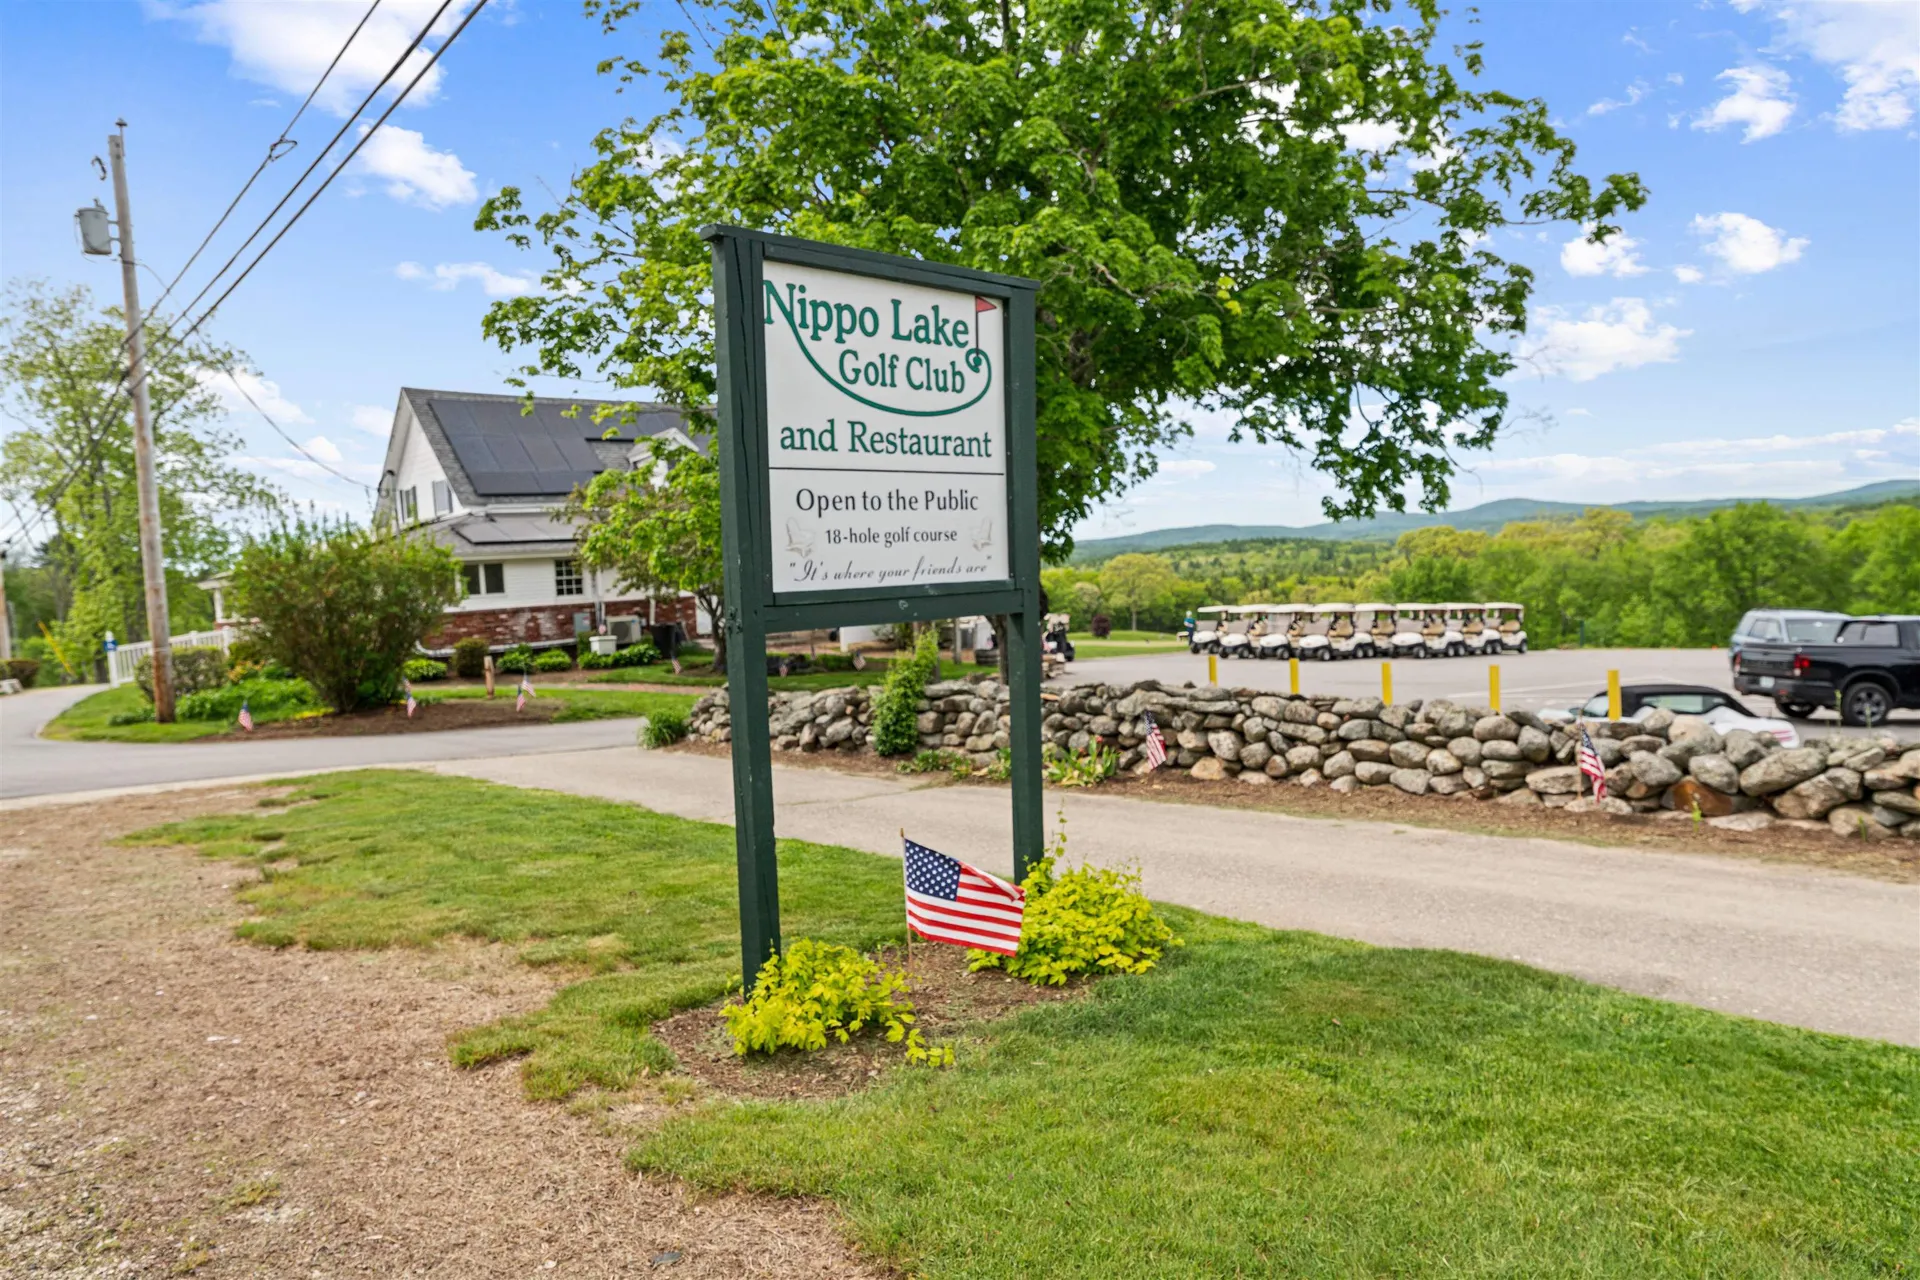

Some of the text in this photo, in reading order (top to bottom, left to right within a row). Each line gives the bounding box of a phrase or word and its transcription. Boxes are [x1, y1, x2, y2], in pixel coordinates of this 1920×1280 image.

[763, 280, 970, 347] Nippo Lake
[839, 349, 966, 394] Golf Club
[780, 419, 992, 458] and Restaurant
[796, 488, 979, 517] Open to the Public
[825, 527, 958, 548] 18-hole golf course
[834, 561, 875, 581] where
[878, 566, 910, 583] your
[912, 556, 963, 581] friends
